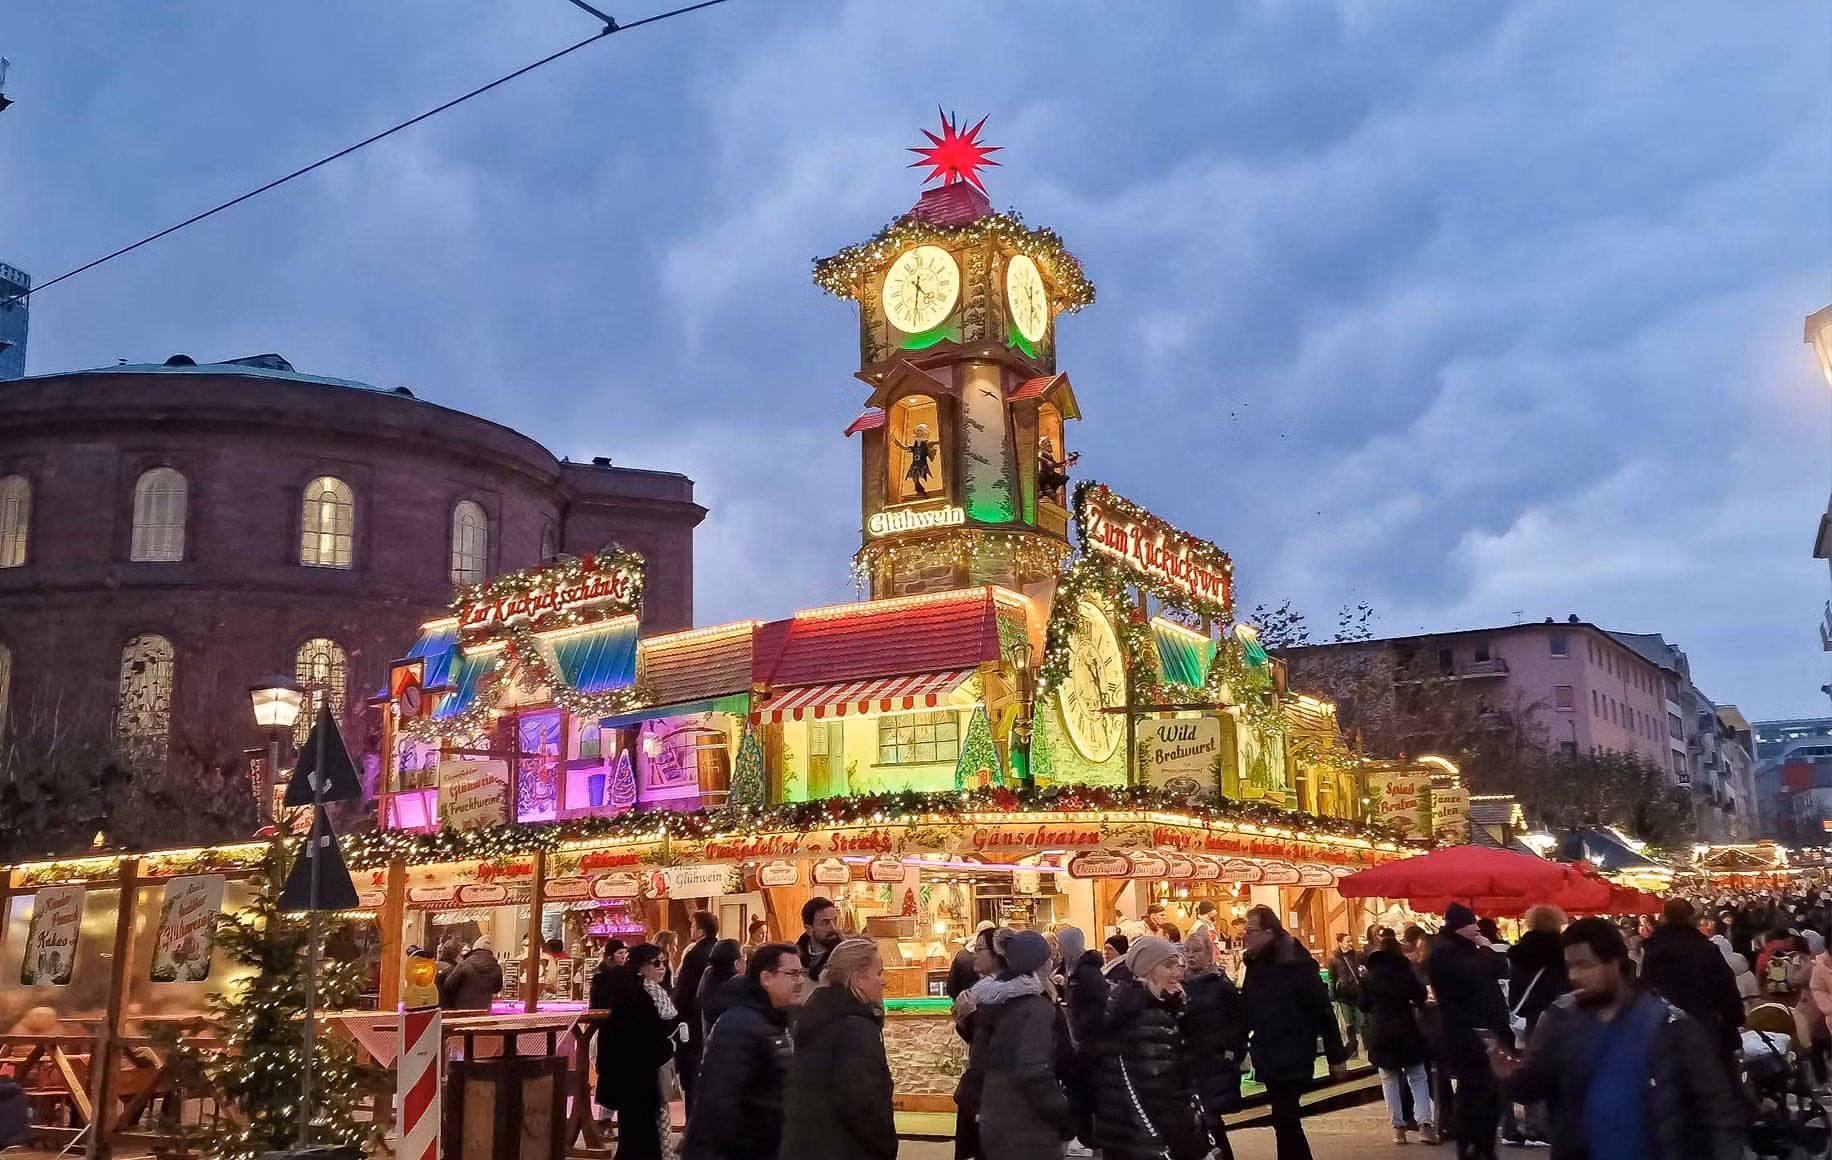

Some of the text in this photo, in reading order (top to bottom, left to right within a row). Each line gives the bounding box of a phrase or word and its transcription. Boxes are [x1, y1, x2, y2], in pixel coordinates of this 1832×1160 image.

[867, 504, 966, 536] Glühwein
[1157, 724, 1197, 742] Wild
[1155, 736, 1217, 764] Bratwurst
[1386, 782, 1415, 797] Spieß
[1381, 799, 1417, 815] Braten
[1432, 806, 1458, 818] raten
[973, 826, 1100, 851] Gänsebraten
[676, 870, 722, 888] Glühwein
[37, 930, 67, 949] Kakao
